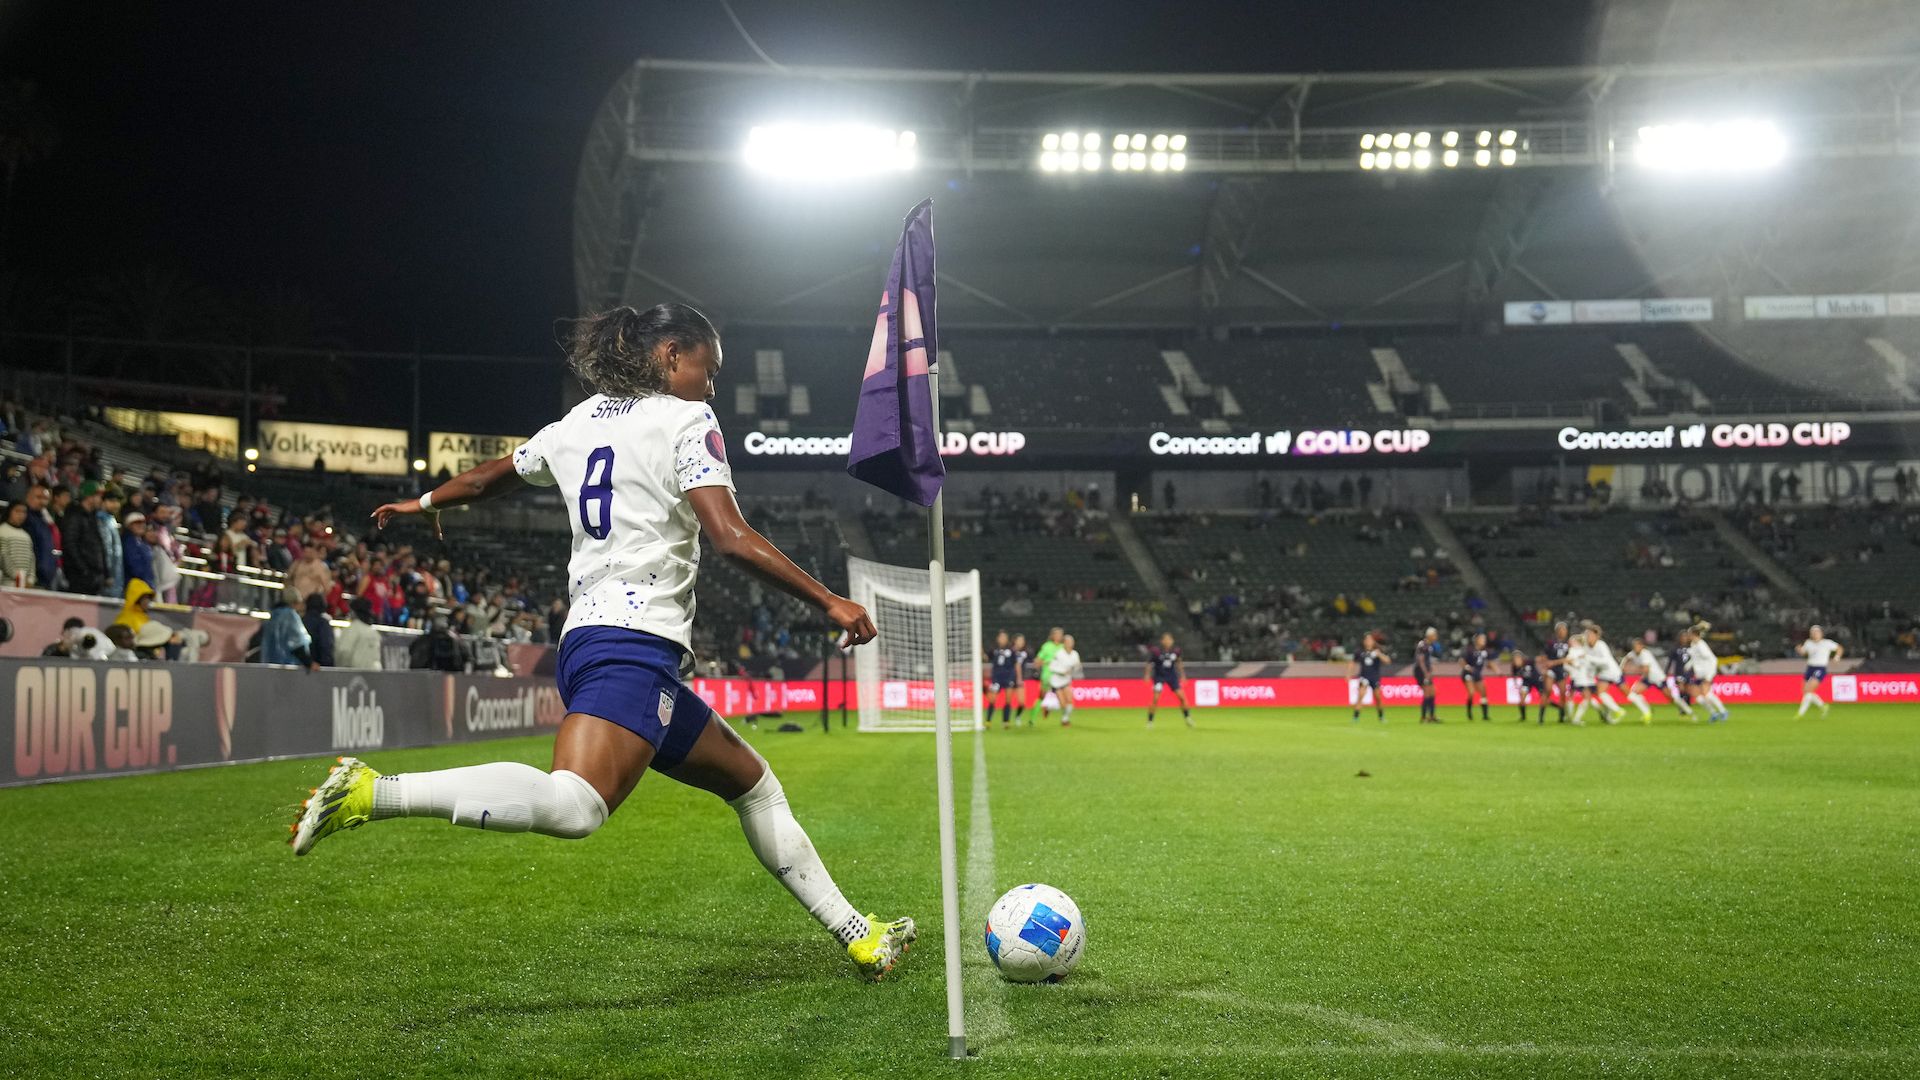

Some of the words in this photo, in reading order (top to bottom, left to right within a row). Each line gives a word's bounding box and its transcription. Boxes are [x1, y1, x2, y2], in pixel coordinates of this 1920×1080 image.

[591, 396, 643, 419] SHAW
[261, 430, 408, 463] Volkswagen
[438, 436, 519, 455] AMERI
[938, 432, 967, 455] LD
[970, 431, 1026, 455] CUP
[1149, 431, 1261, 455] Concacaf
[1296, 430, 1371, 454] GOLD
[1373, 430, 1430, 453] CUP
[1558, 427, 1674, 450] Concacaf
[1712, 424, 1789, 448] GOLD
[1792, 422, 1850, 446] CUP
[579, 446, 615, 540] 8
[1221, 685, 1276, 700] TOYOTA
[1859, 681, 1918, 696] TOYOTA
[15, 666, 96, 777] OUR
[105, 668, 177, 769] CUP.
[332, 686, 384, 749] Modelo
[465, 685, 523, 732] Concacaf
